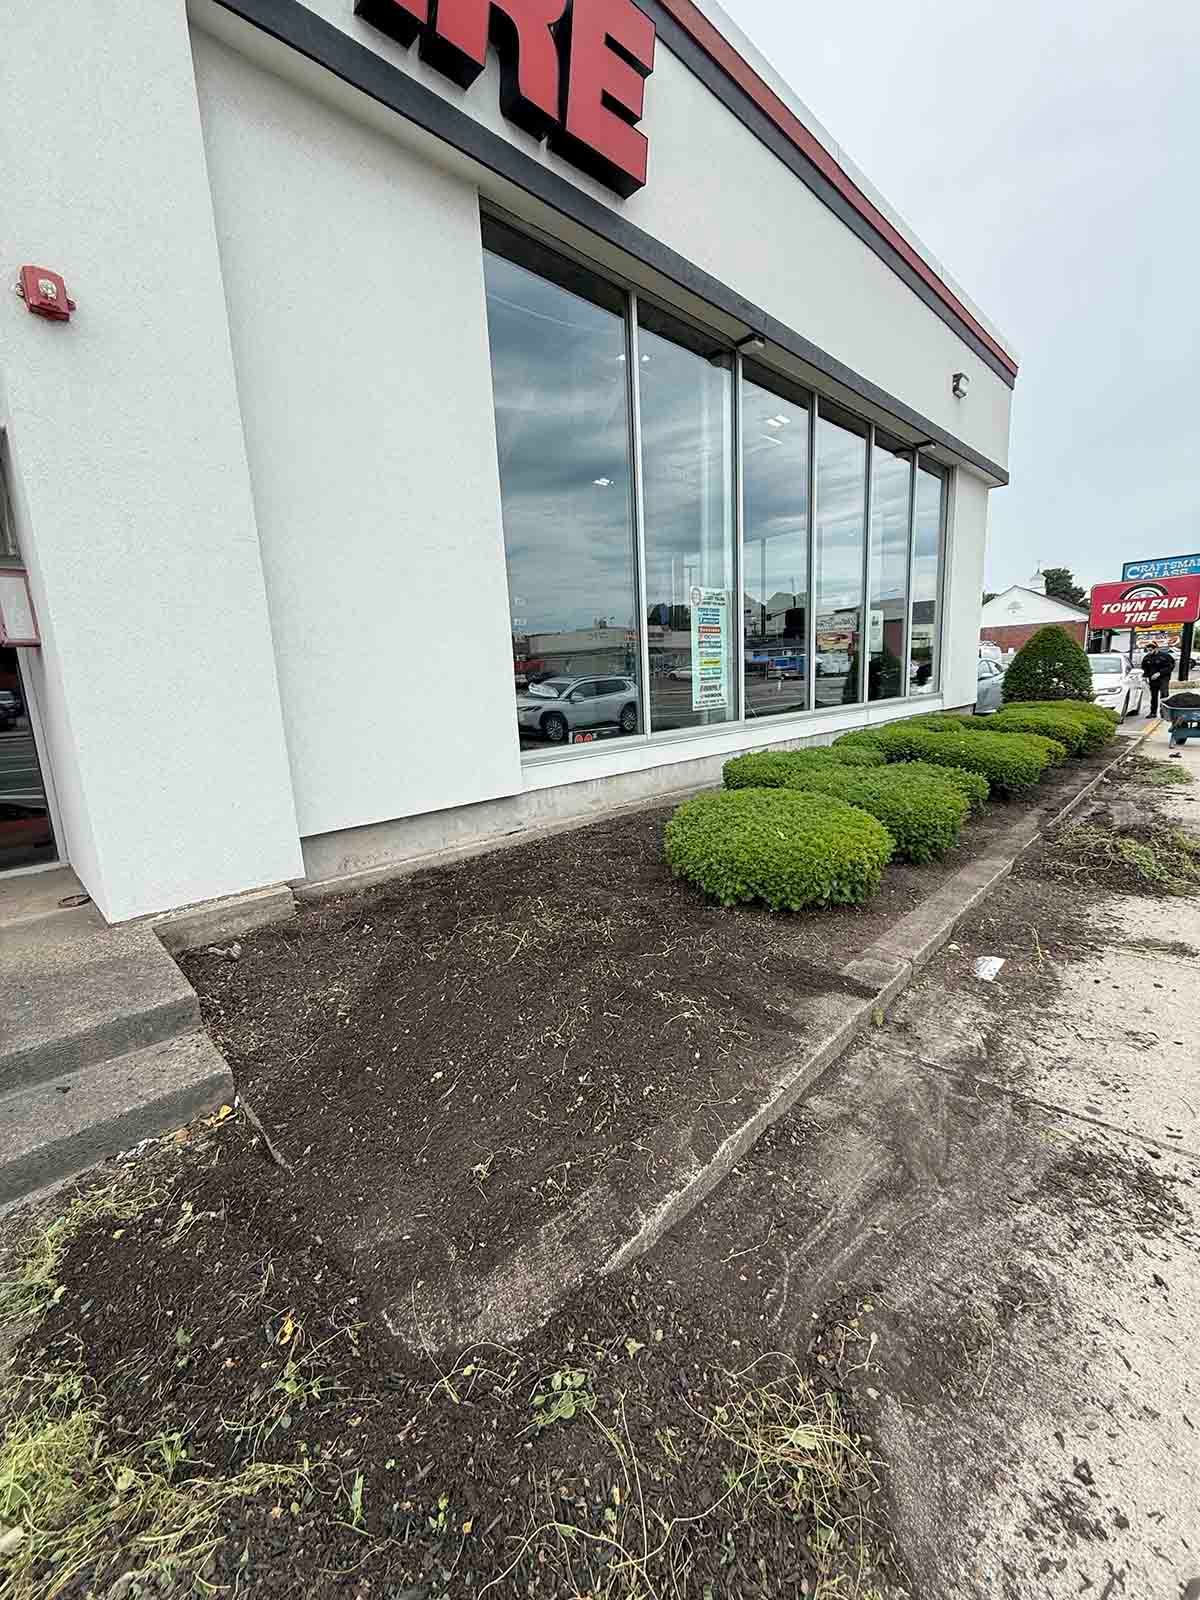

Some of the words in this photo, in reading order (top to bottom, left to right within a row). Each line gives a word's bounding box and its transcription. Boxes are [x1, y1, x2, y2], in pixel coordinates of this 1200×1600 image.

[1101, 600, 1145, 614] TOWN
[1149, 597, 1188, 610] FAIR
[1124, 611, 1160, 623] TIRE
